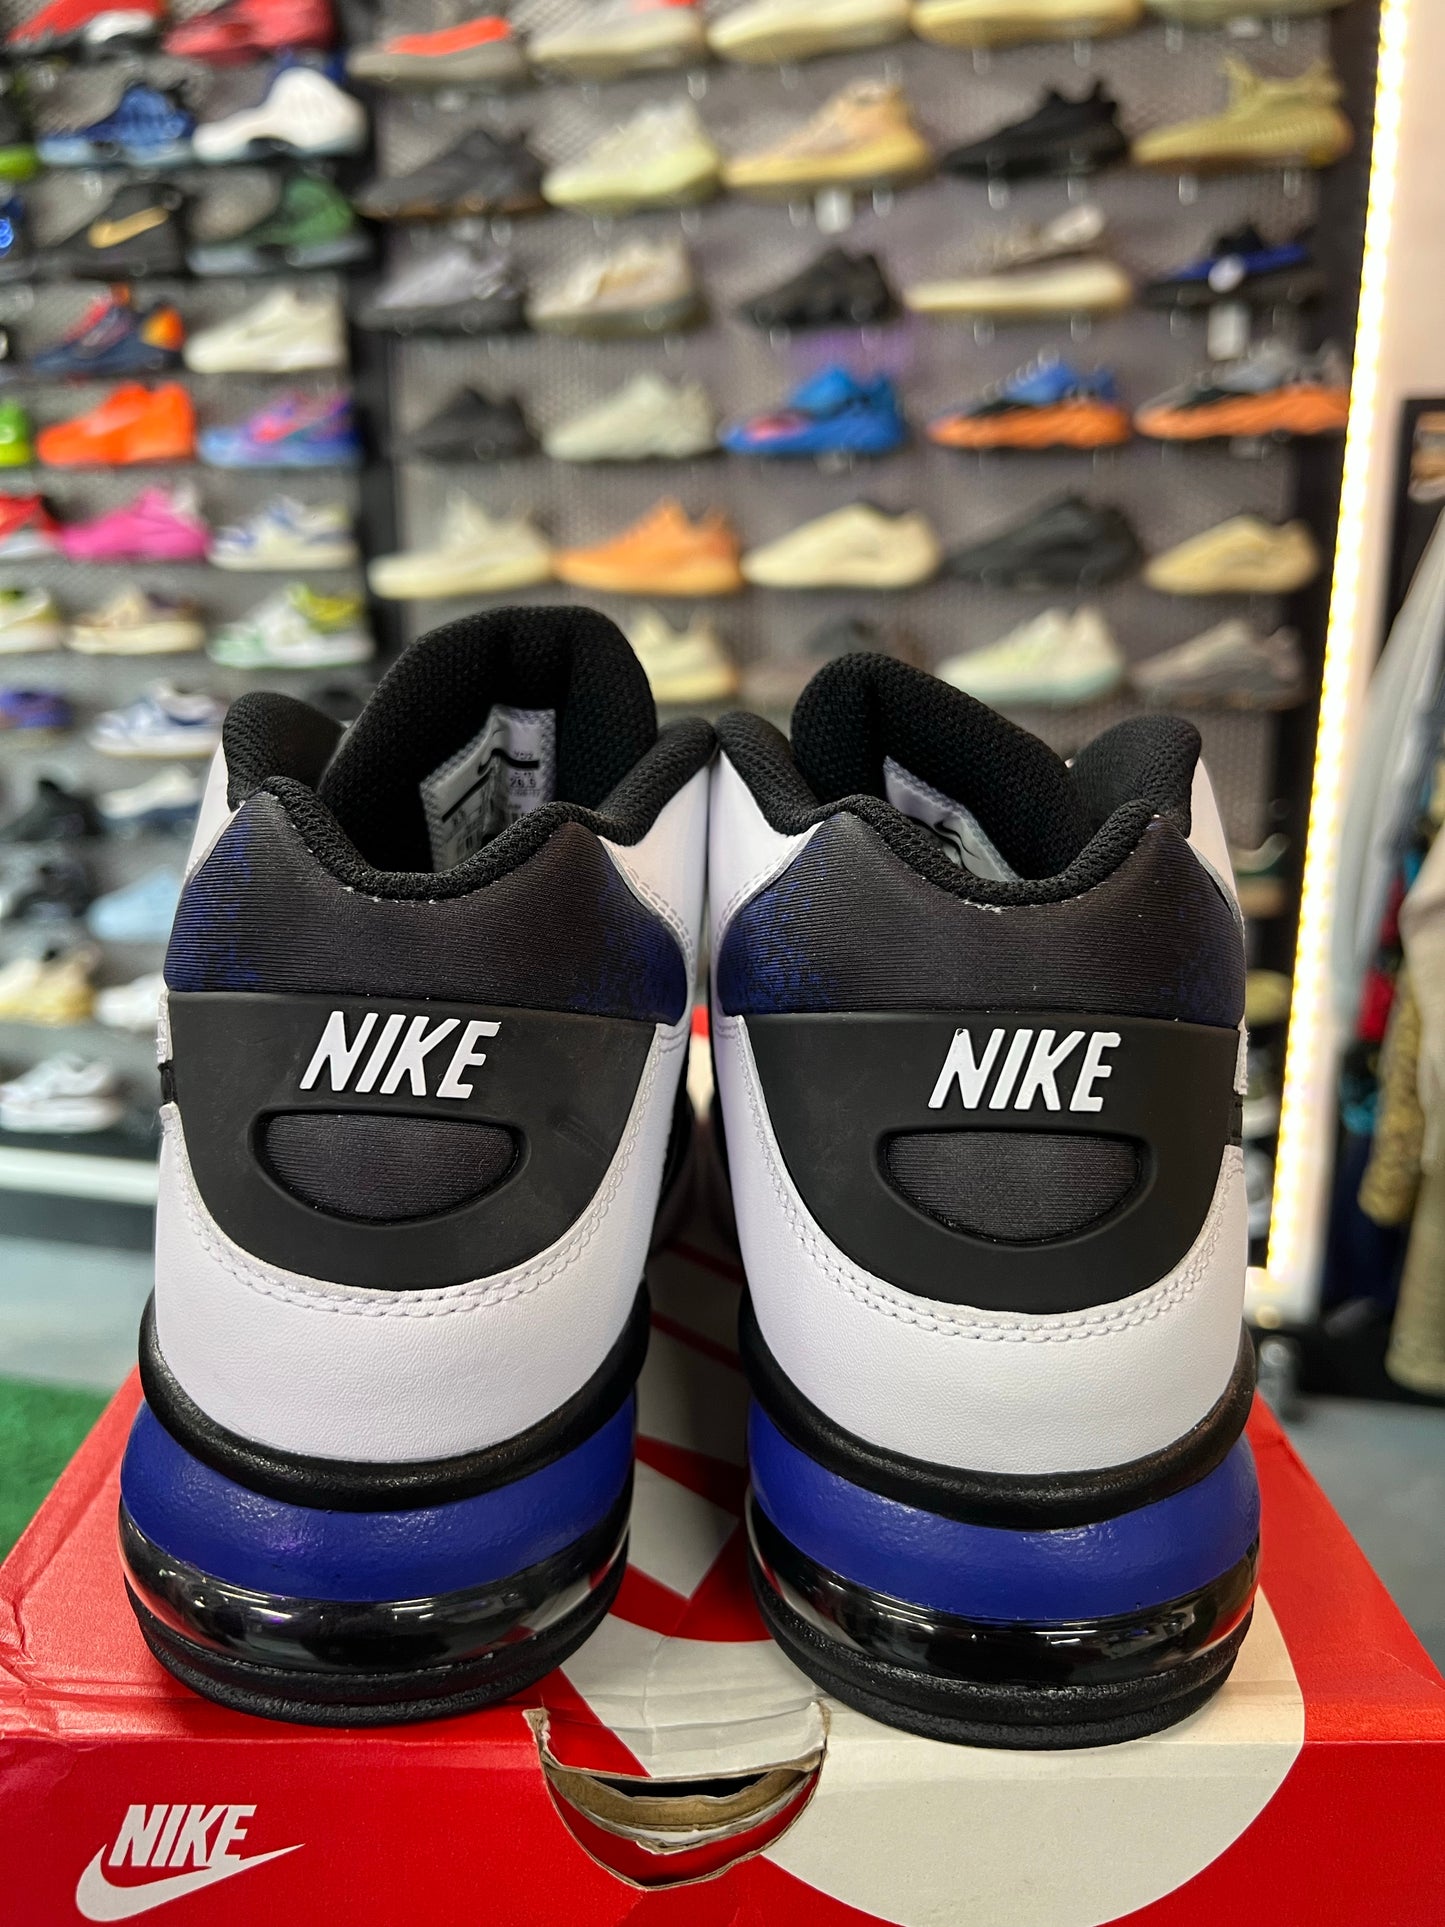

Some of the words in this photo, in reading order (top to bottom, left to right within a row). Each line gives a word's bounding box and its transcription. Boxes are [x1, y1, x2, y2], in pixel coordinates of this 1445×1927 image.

[300, 1011, 502, 1099] NIKE
[928, 1029, 1122, 1113] NIKE
[109, 1804, 257, 1867] NIKE
